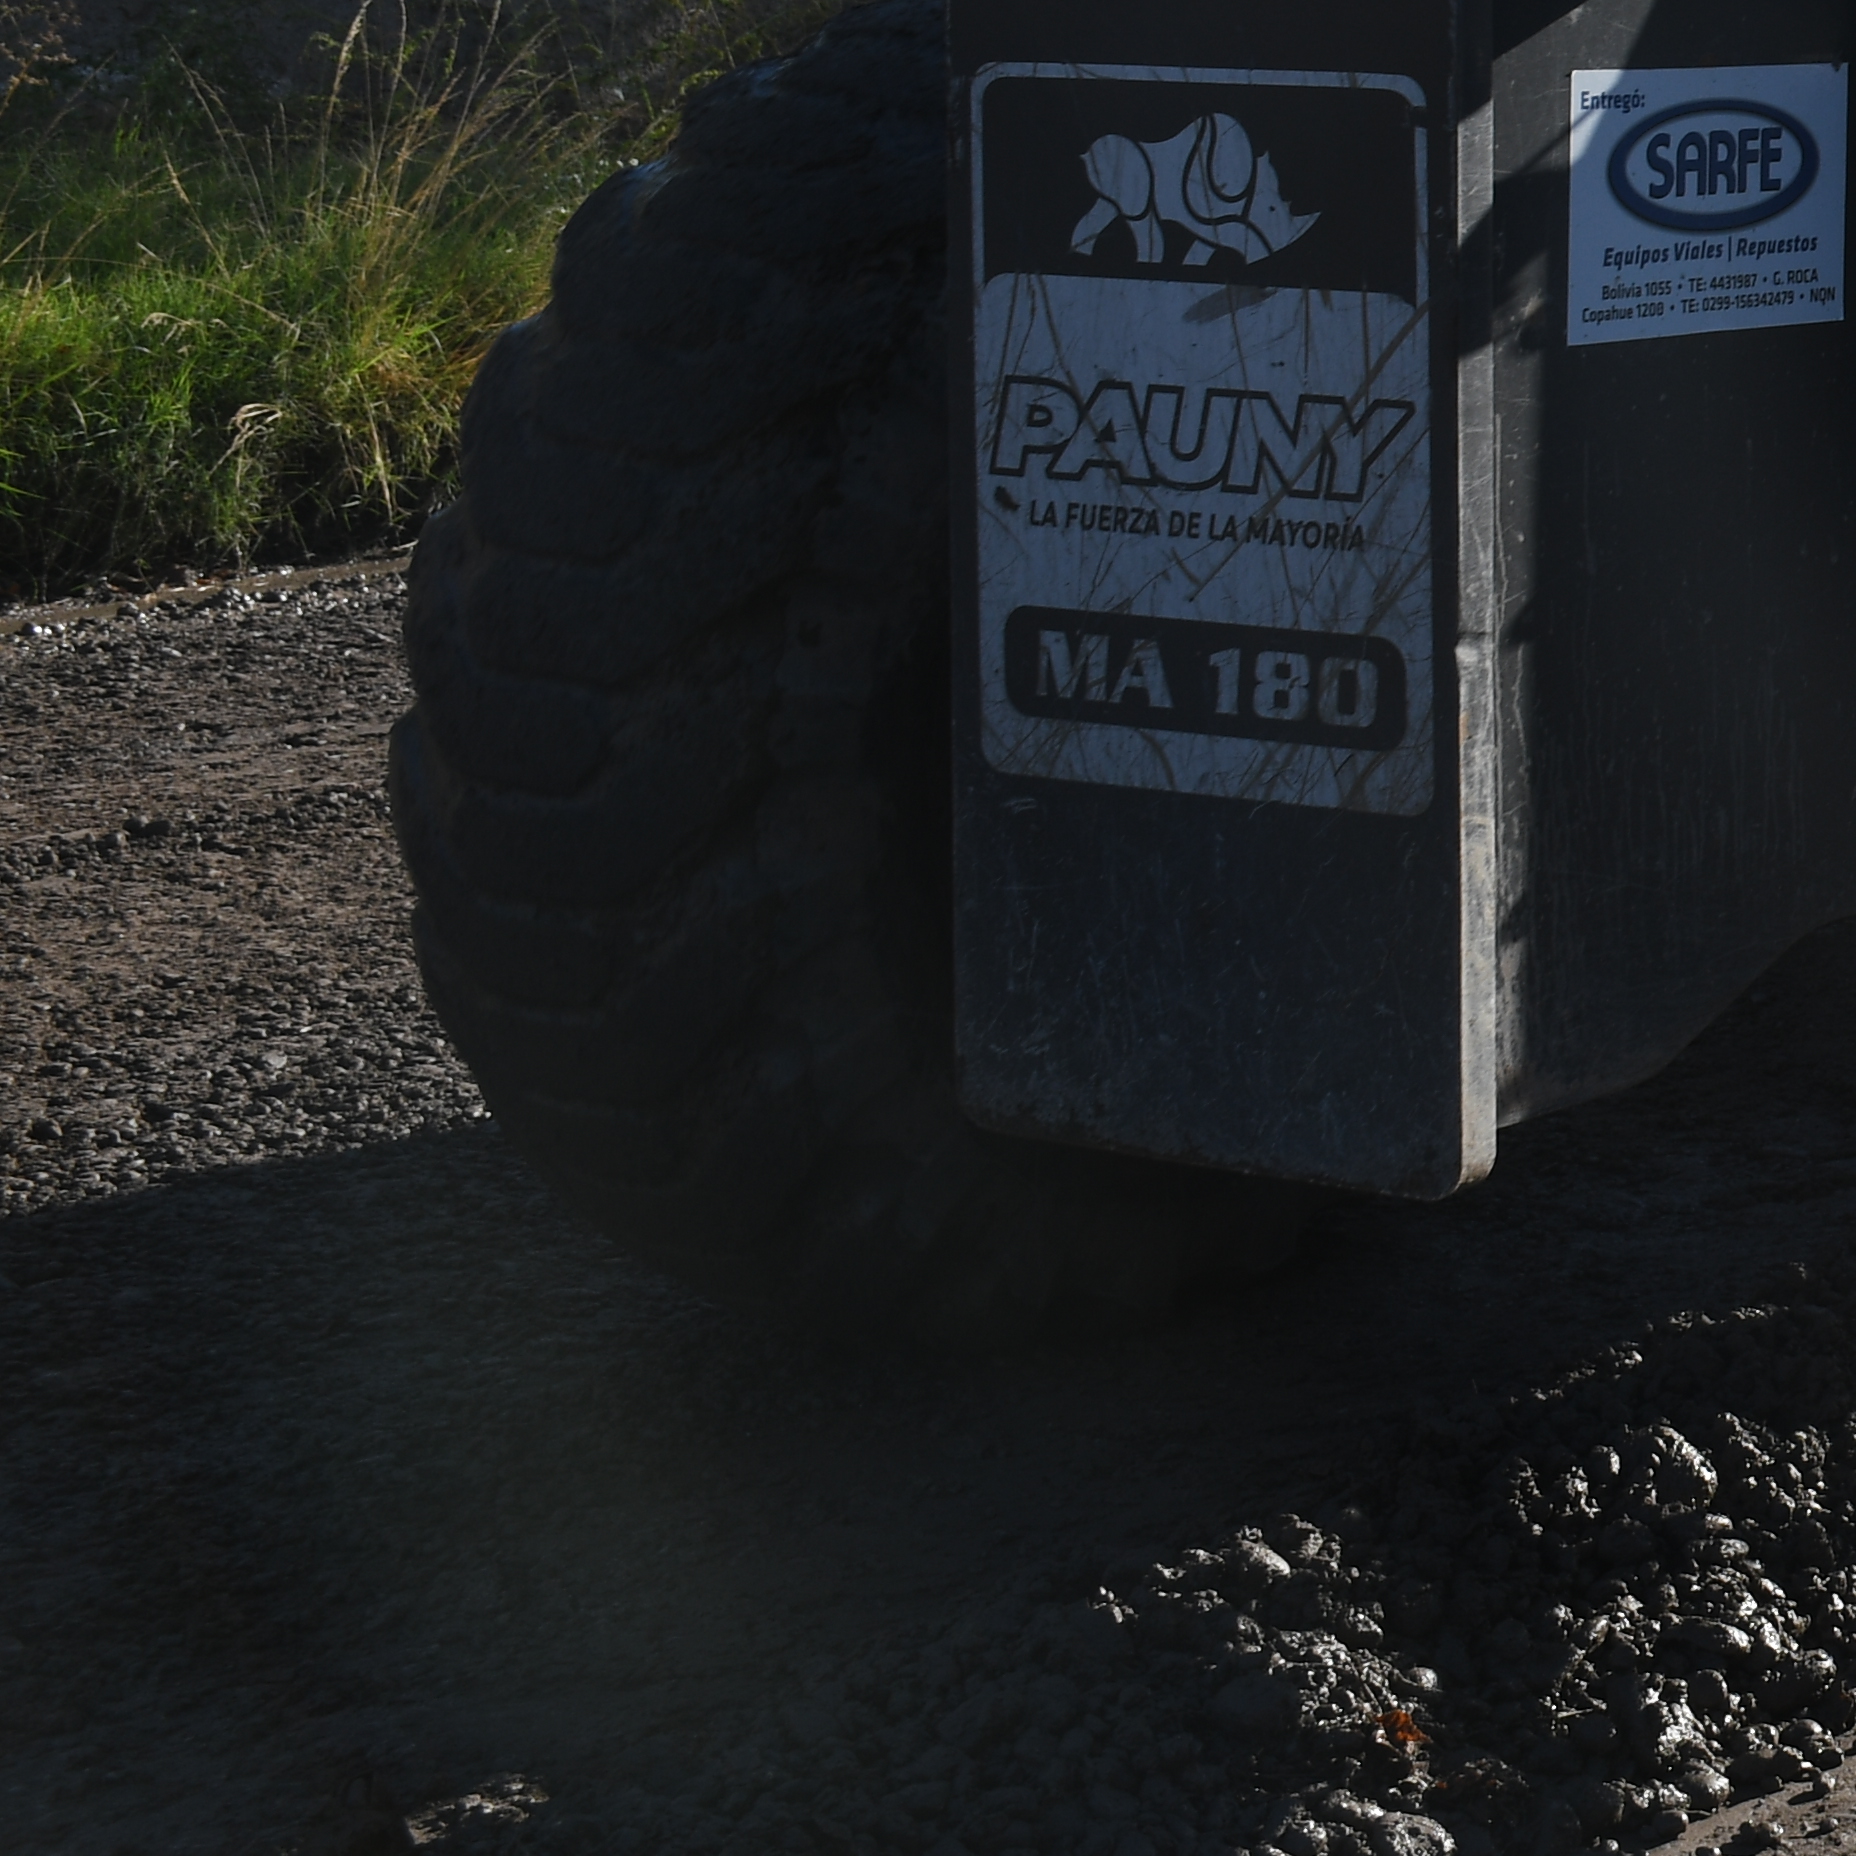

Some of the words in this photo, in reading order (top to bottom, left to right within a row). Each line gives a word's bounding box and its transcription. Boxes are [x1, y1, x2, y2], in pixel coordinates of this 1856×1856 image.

[1580, 89, 1647, 114] Entregó:
[1646, 126, 1783, 200] SARFE
[1602, 244, 1670, 271] Equipos
[1674, 240, 1724, 261] Viales
[1736, 234, 1819, 260] Repuestos
[1582, 304, 1633, 326] Copahue
[1680, 298, 1700, 314] TE:
[1809, 287, 1836, 305] NQN
[1602, 282, 1642, 300] Bolivia
[1644, 280, 1672, 297] 1055
[1688, 277, 1707, 293] TE:
[1709, 274, 1758, 291] 4431987
[1787, 268, 1819, 284] ROCA
[988, 374, 1416, 503] PAUNY
[1028, 499, 1058, 528] LA
[1065, 502, 1160, 536] FUERZA
[1169, 509, 1200, 540] DE
[1208, 512, 1239, 544] LA
[1246, 515, 1365, 551] MAYORÍA
[1036, 629, 1175, 710] MA
[1208, 647, 1380, 729] 180
